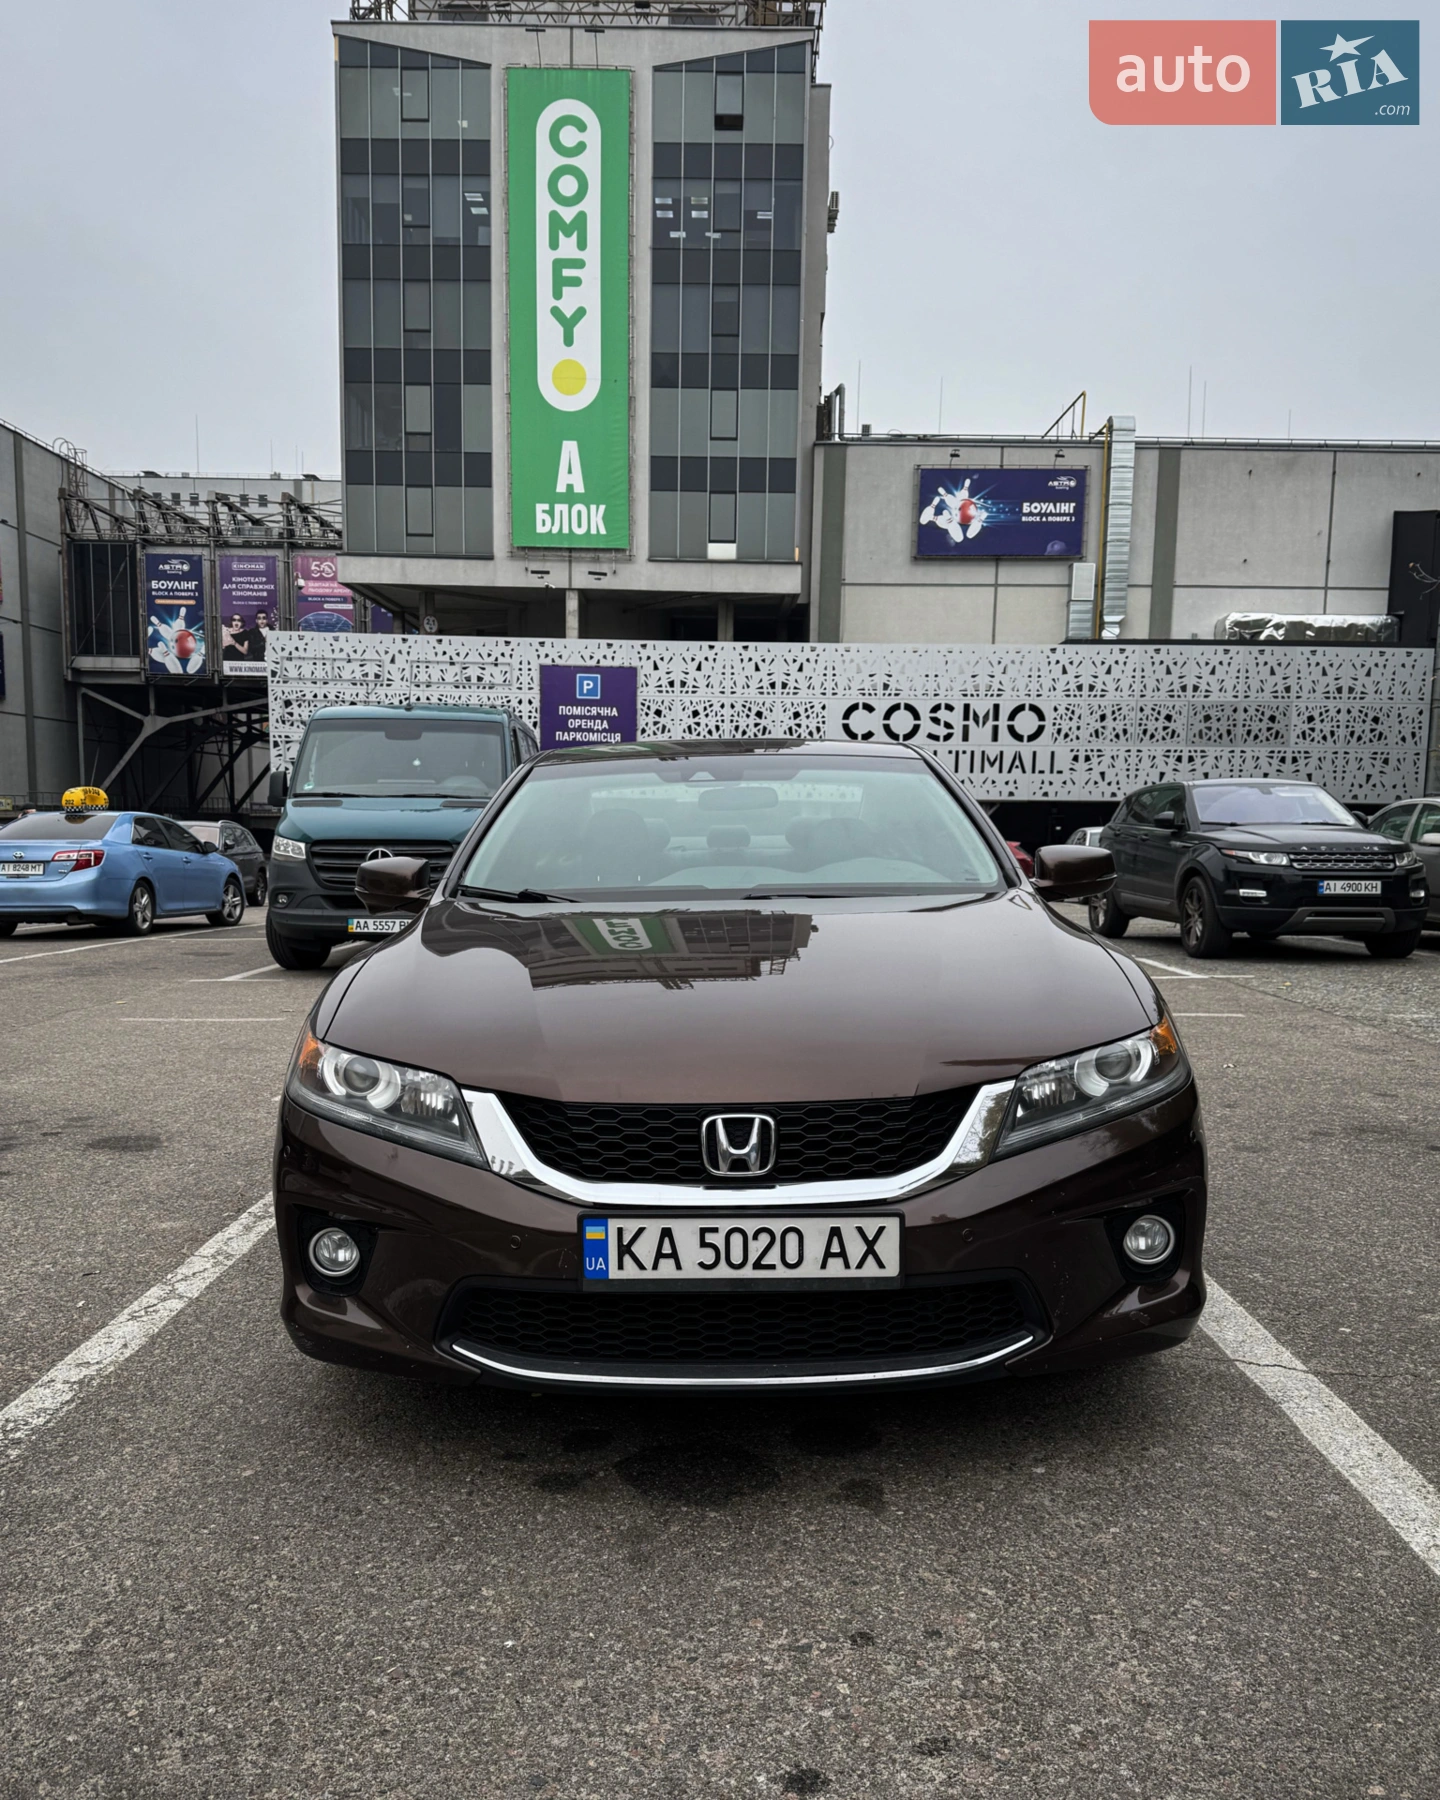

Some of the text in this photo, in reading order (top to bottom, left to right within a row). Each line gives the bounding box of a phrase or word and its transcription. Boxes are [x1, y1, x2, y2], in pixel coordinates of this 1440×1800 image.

[547, 114, 589, 348] COMFY
[555, 440, 585, 493] А
[1022, 502, 1076, 513] БОУЛІНГ
[535, 503, 607, 535] БЛОК
[151, 580, 199, 590] БОУЛІНГ
[583, 680, 594, 694] P
[558, 705, 618, 717] ПОМІСЯЧНА
[567, 718, 609, 731] ОРЕНДА
[841, 701, 1046, 743] COSMO
[555, 731, 621, 744] ПАРКОМІСЦЯ
[1324, 882, 1337, 892] AI
[1340, 882, 1362, 892] 4900
[1364, 882, 1378, 892] KH
[355, 920, 369, 931] AA
[373, 920, 397, 931] 5557
[616, 1225, 888, 1271] KA 5020 AX
[585, 1257, 607, 1272] UA
